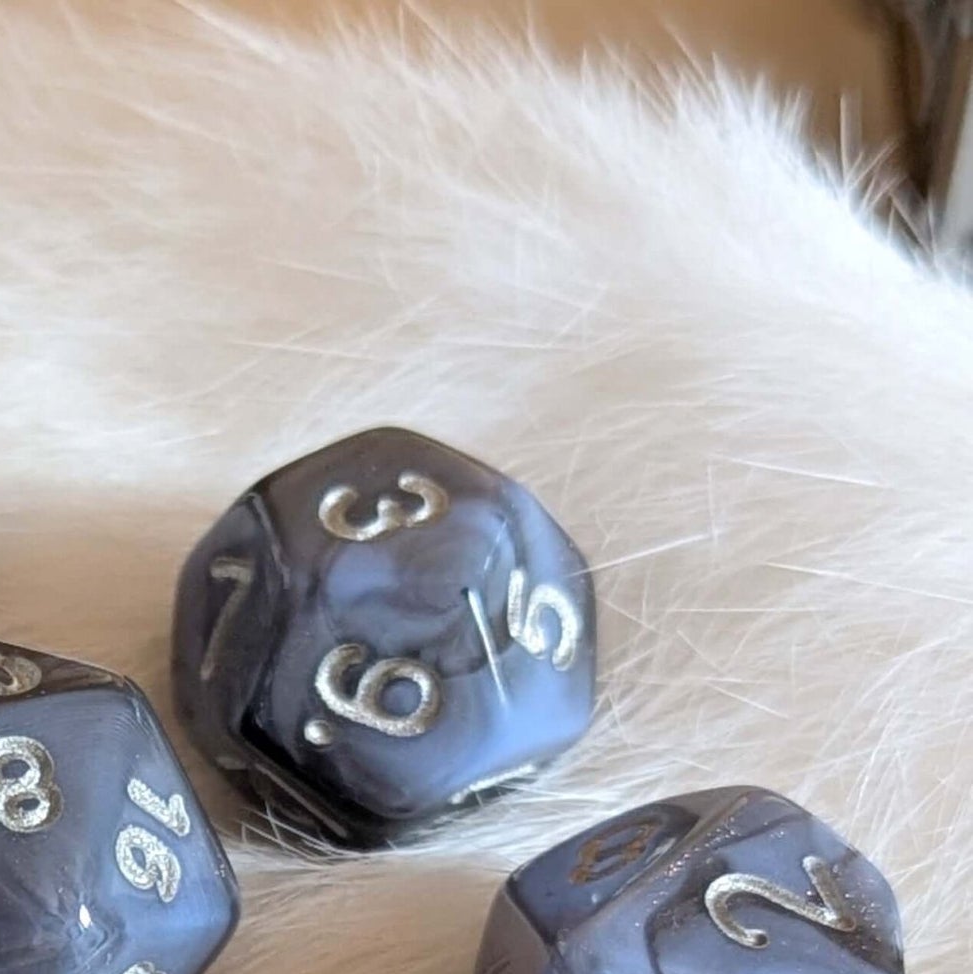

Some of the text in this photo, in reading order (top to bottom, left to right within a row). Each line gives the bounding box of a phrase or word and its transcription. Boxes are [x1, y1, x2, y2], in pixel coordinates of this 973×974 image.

[319, 472, 449, 541] 3
[199, 556, 257, 681] 7
[507, 569, 581, 672] 5
[705, 855, 856, 949] 2
